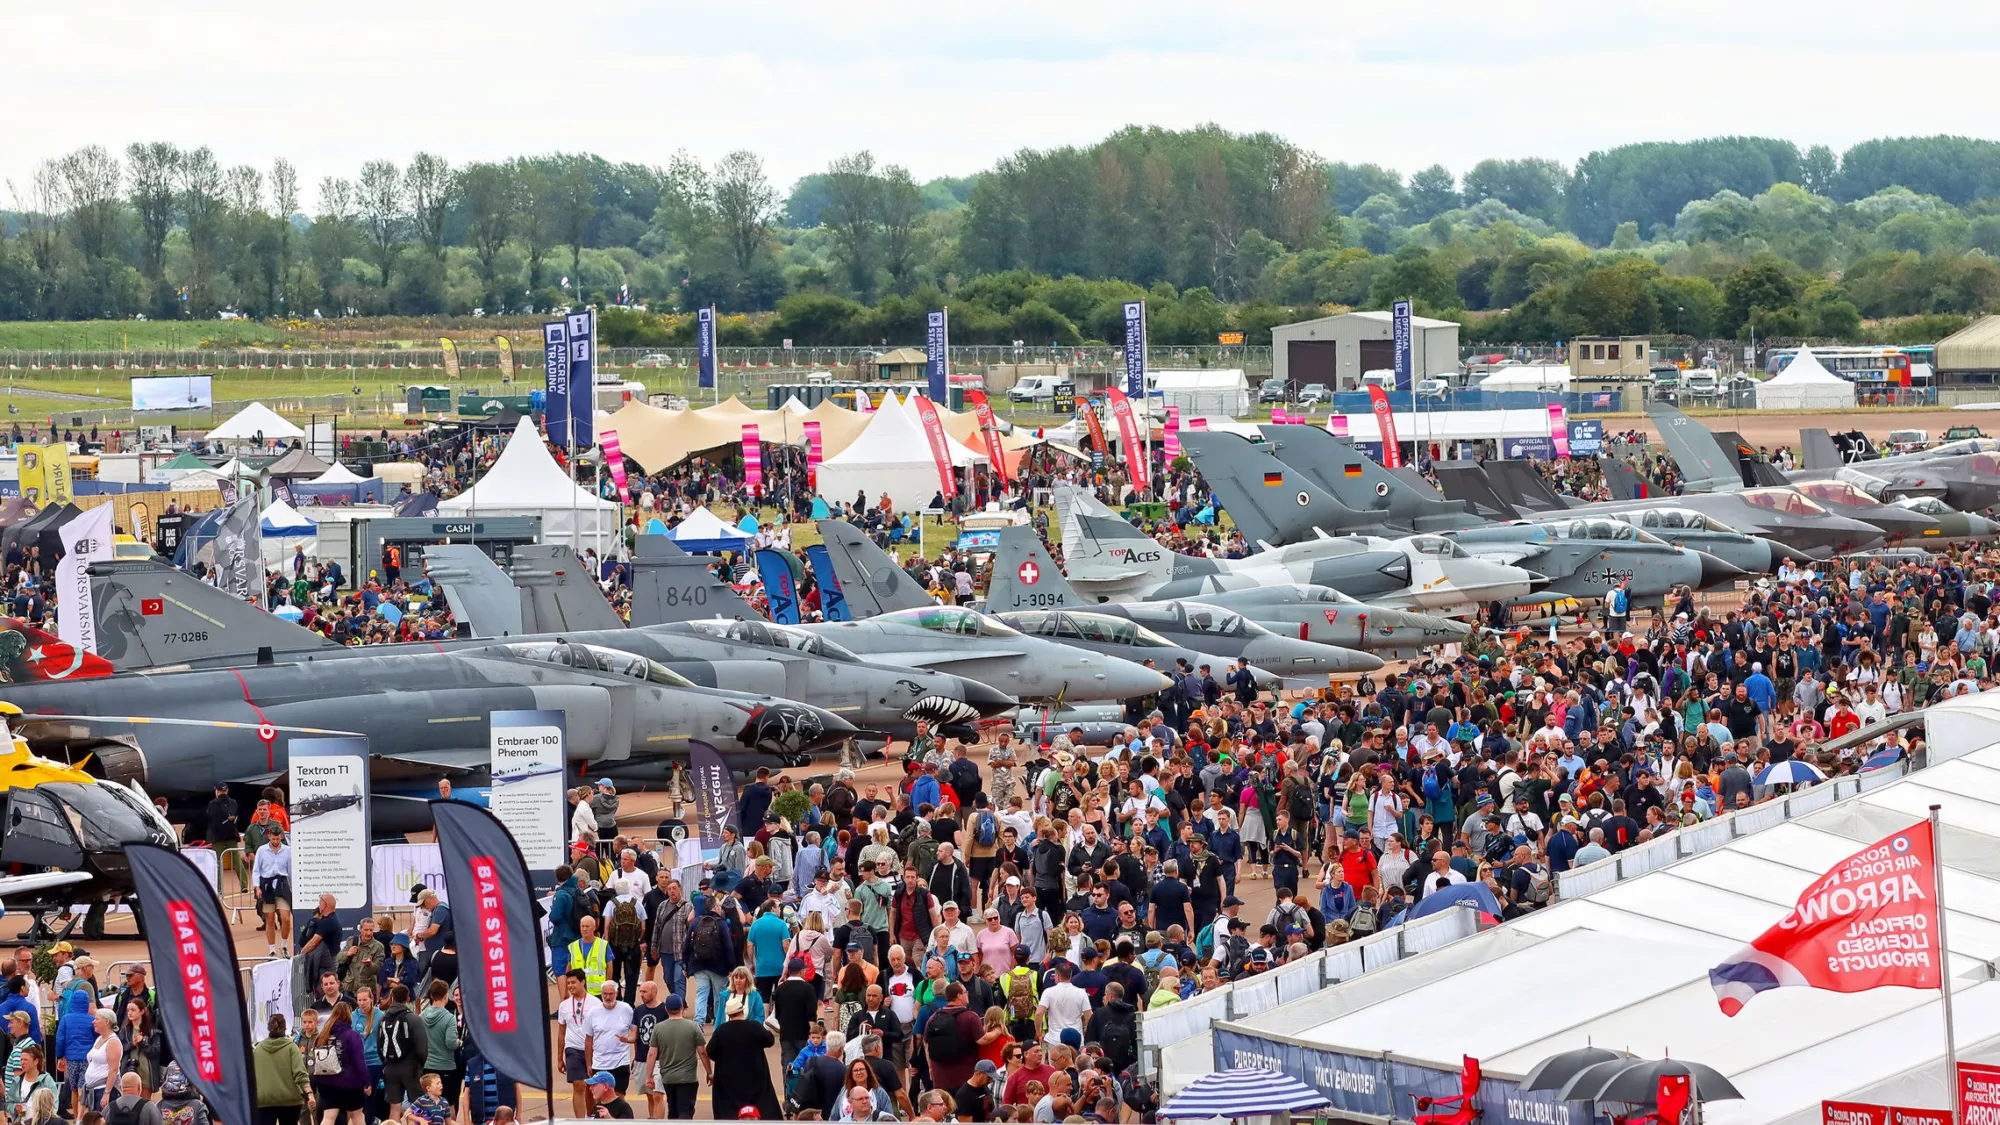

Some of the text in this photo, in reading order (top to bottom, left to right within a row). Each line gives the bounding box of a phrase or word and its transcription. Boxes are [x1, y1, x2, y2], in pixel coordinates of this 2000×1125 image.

[928, 327, 936, 361] STATION
[936, 327, 944, 375] REFUELLING
[1394, 318, 1403, 373] MERCHANDISE
[547, 345, 557, 392] TRADING
[557, 344, 567, 395] AIRCREW
[1673, 417, 1687, 426] 372
[445, 524, 471, 533] CASH
[551, 547, 568, 558] 27
[1108, 547, 1161, 565] TOP ACES
[1583, 568, 1634, 584] 45 39
[778, 572, 791, 597] TOP
[666, 586, 707, 606] 840
[1013, 593, 1064, 607] J-3094
[497, 735, 559, 746] Embraer 100
[498, 748, 538, 757] Phenom
[296, 765, 349, 775] Textron T1
[297, 778, 328, 788] Texan
[151, 833, 168, 846] 22
[477, 865, 510, 1024] BAE SYSTEMS
[175, 910, 215, 1075] BAE SYSTEMS
[1974, 1093, 1989, 1103] FORCE
[1525, 1100, 1555, 1125] GLOBAL
[1849, 1111, 1872, 1125] RED
